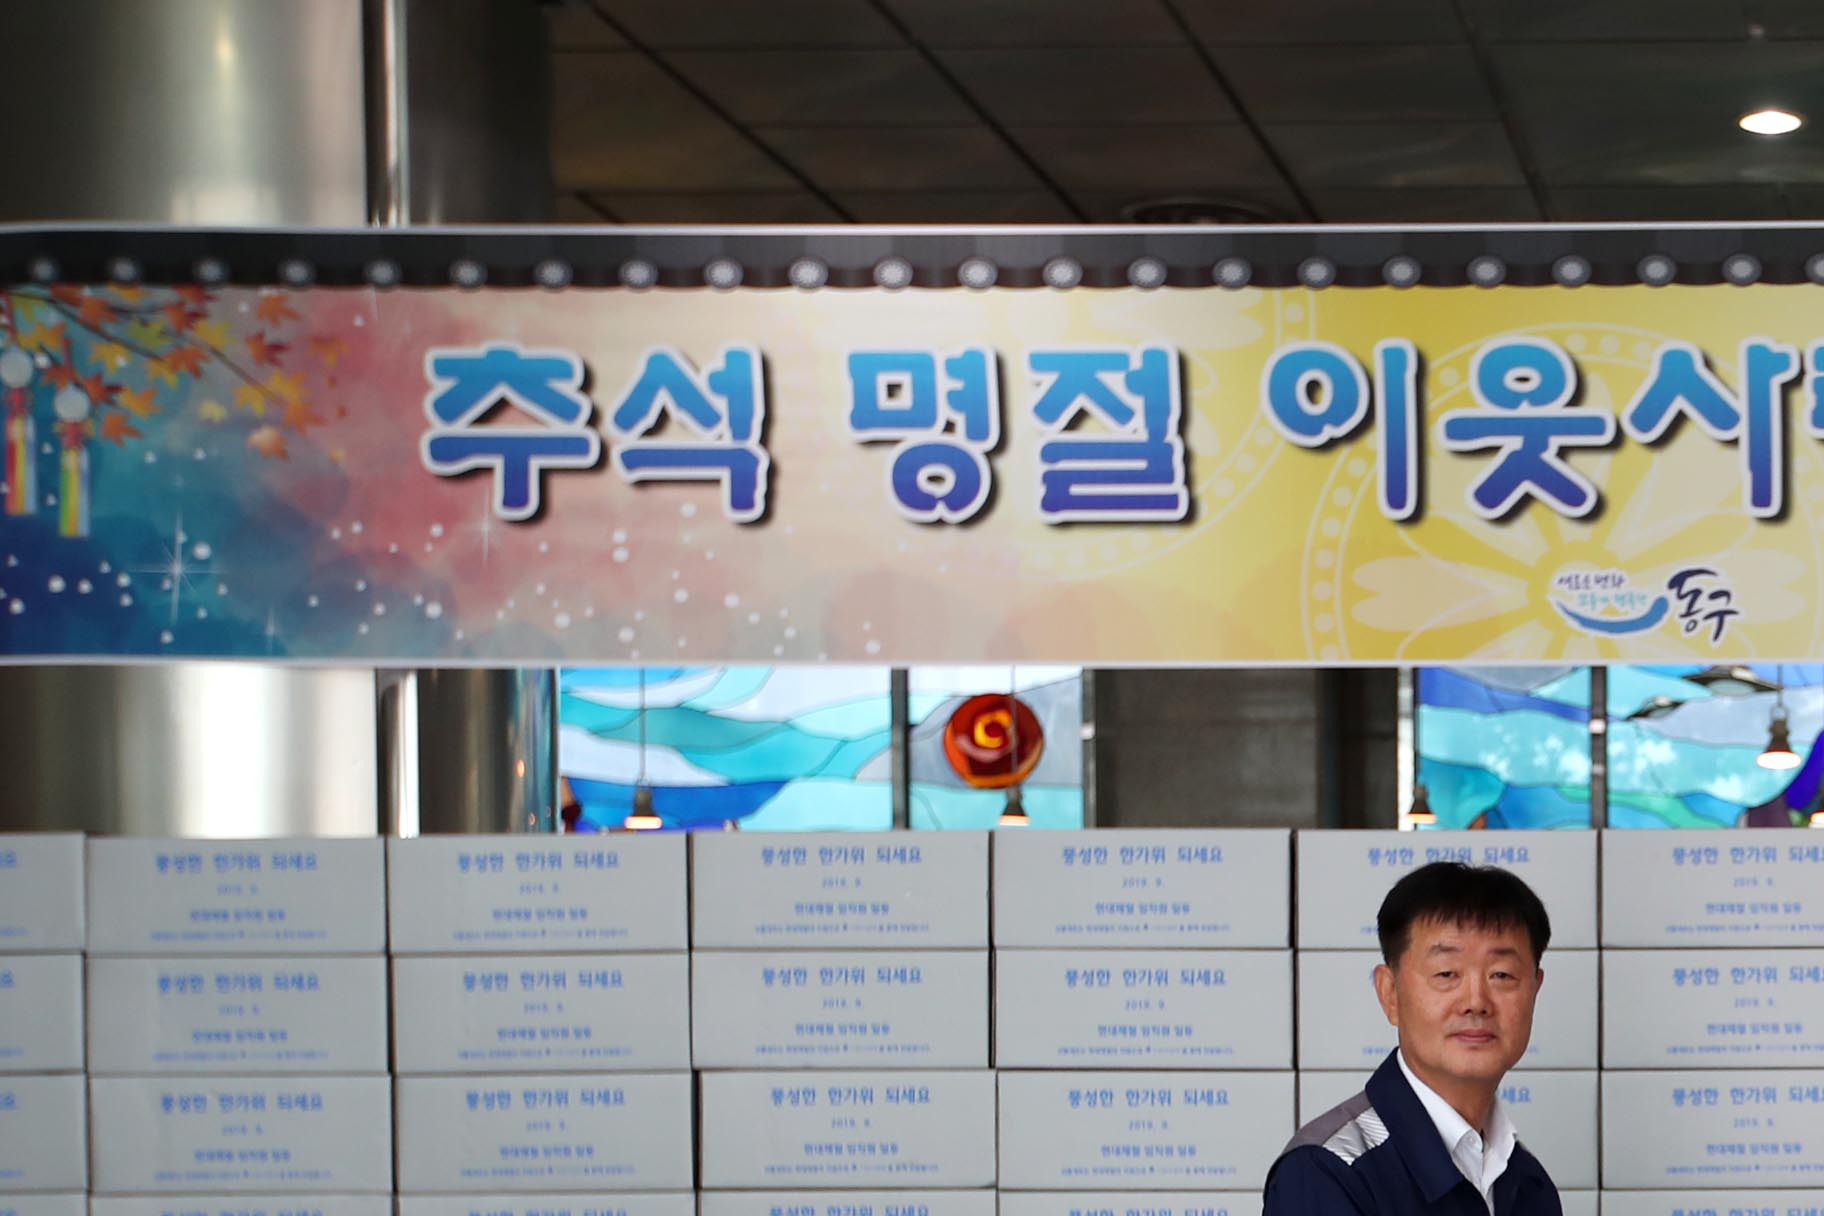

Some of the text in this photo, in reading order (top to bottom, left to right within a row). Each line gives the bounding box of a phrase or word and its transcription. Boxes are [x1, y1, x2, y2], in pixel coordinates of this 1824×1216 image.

[425, 343, 770, 520] 추석
[845, 344, 1189, 521] 명절
[1667, 568, 1739, 643] 동구
[1062, 847, 1222, 865] 풍성한 한가위 되세요
[1672, 847, 1718, 865] 풍성한
[1730, 847, 1776, 864] 한가위
[1068, 1089, 1228, 1108] 풍성한 한가위 되세요
[1672, 1088, 1718, 1106] 풍성한
[1730, 1087, 1776, 1104] 한가위
